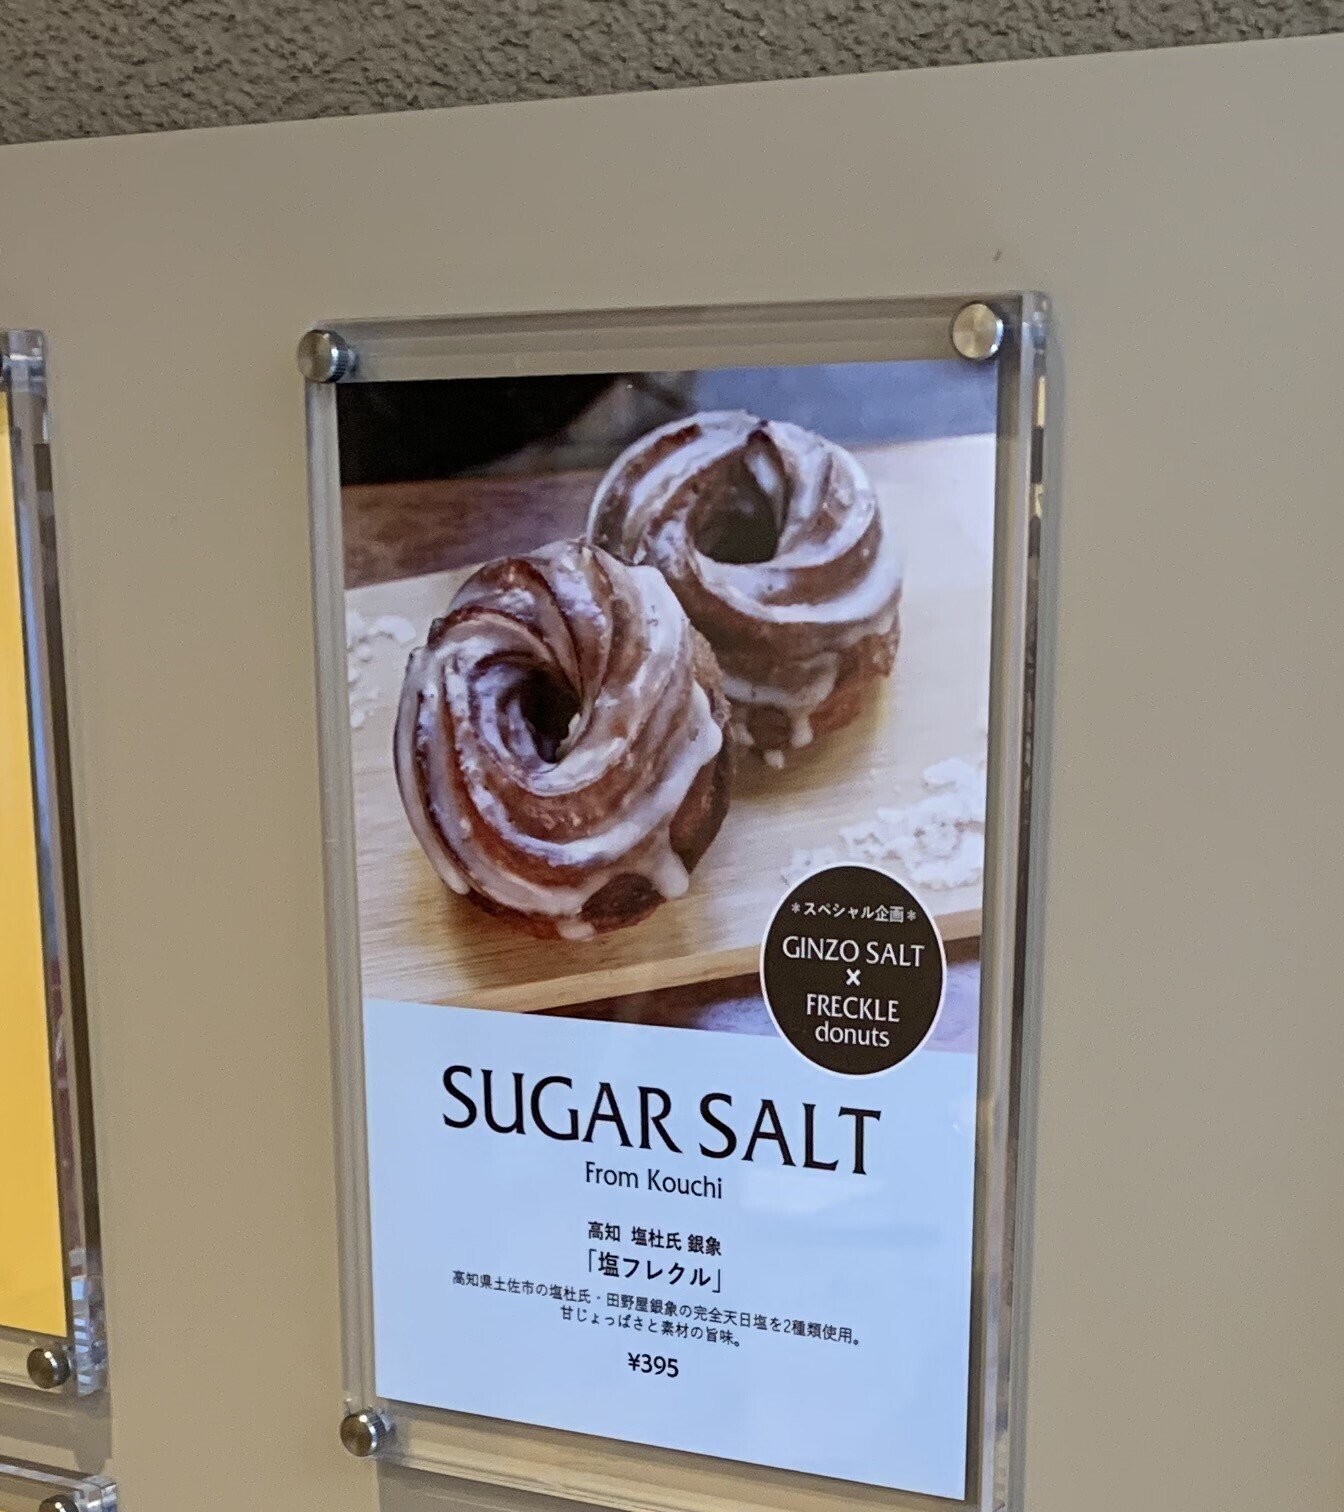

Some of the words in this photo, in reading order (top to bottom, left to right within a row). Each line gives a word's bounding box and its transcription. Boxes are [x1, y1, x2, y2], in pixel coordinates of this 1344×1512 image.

[782, 936, 859, 963] GINZO
[866, 941, 925, 967] SALT
[806, 993, 901, 1022] FRECKLE
[815, 1020, 890, 1047] donuts
[441, 1065, 683, 1154] SUGAR
[698, 1092, 882, 1176] SALT
[585, 1161, 639, 1189] From
[647, 1168, 723, 1199] Kouchi
[587, 1221, 621, 1243] 高知
[631, 1225, 683, 1251] 塩杜氏
[688, 1233, 723, 1256] 銀象
[588, 1248, 722, 1293] 「塩フレクル」
[627, 1352, 680, 1378] ¥395
